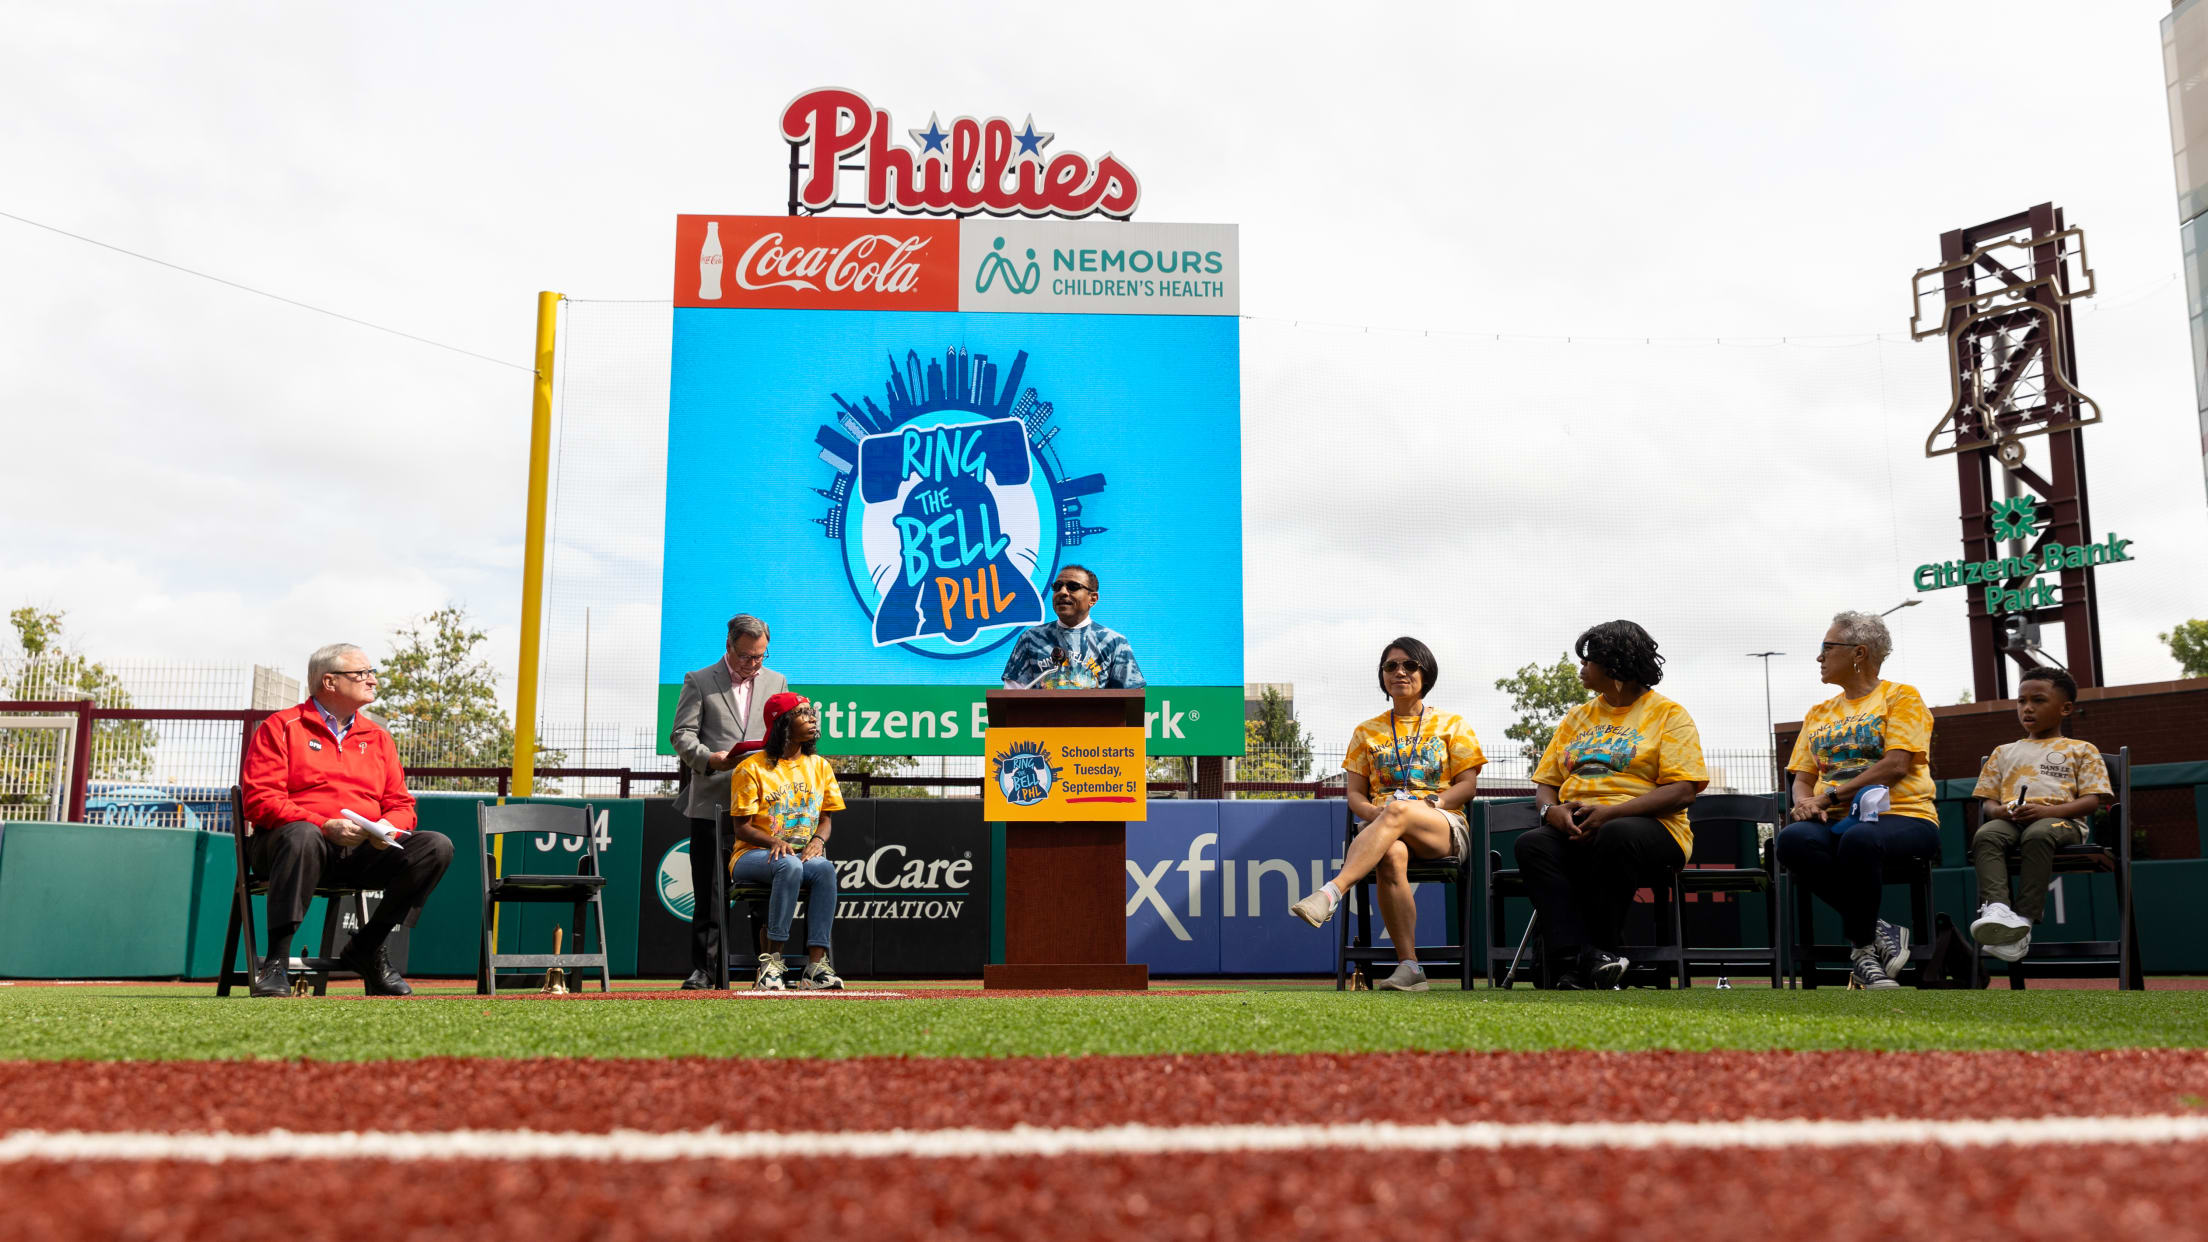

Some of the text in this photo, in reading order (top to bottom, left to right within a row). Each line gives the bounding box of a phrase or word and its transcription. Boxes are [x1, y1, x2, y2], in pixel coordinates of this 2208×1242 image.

[780, 86, 1141, 216] Phillies
[735, 232, 933, 293] Coca-Cola
[1053, 248, 1224, 274] NEMOURS
[1052, 279, 1224, 298] CHILDREN'S HEALTH
[902, 429, 987, 482] RING
[915, 486, 952, 515] THE
[896, 504, 1011, 587] BELL
[1913, 532, 2130, 592] Citizens Bank
[935, 563, 1016, 630] PHL
[1984, 577, 2057, 615] Park
[813, 701, 960, 738] itizens
[1013, 757, 1035, 770] RING
[1061, 745, 1135, 758] School starts
[1012, 773, 1040, 791] BELL
[1073, 763, 1122, 778] Tuesday,
[1022, 786, 1042, 800] PHL
[1062, 781, 1137, 795] September 5!
[1126, 832, 1420, 941] xfini
